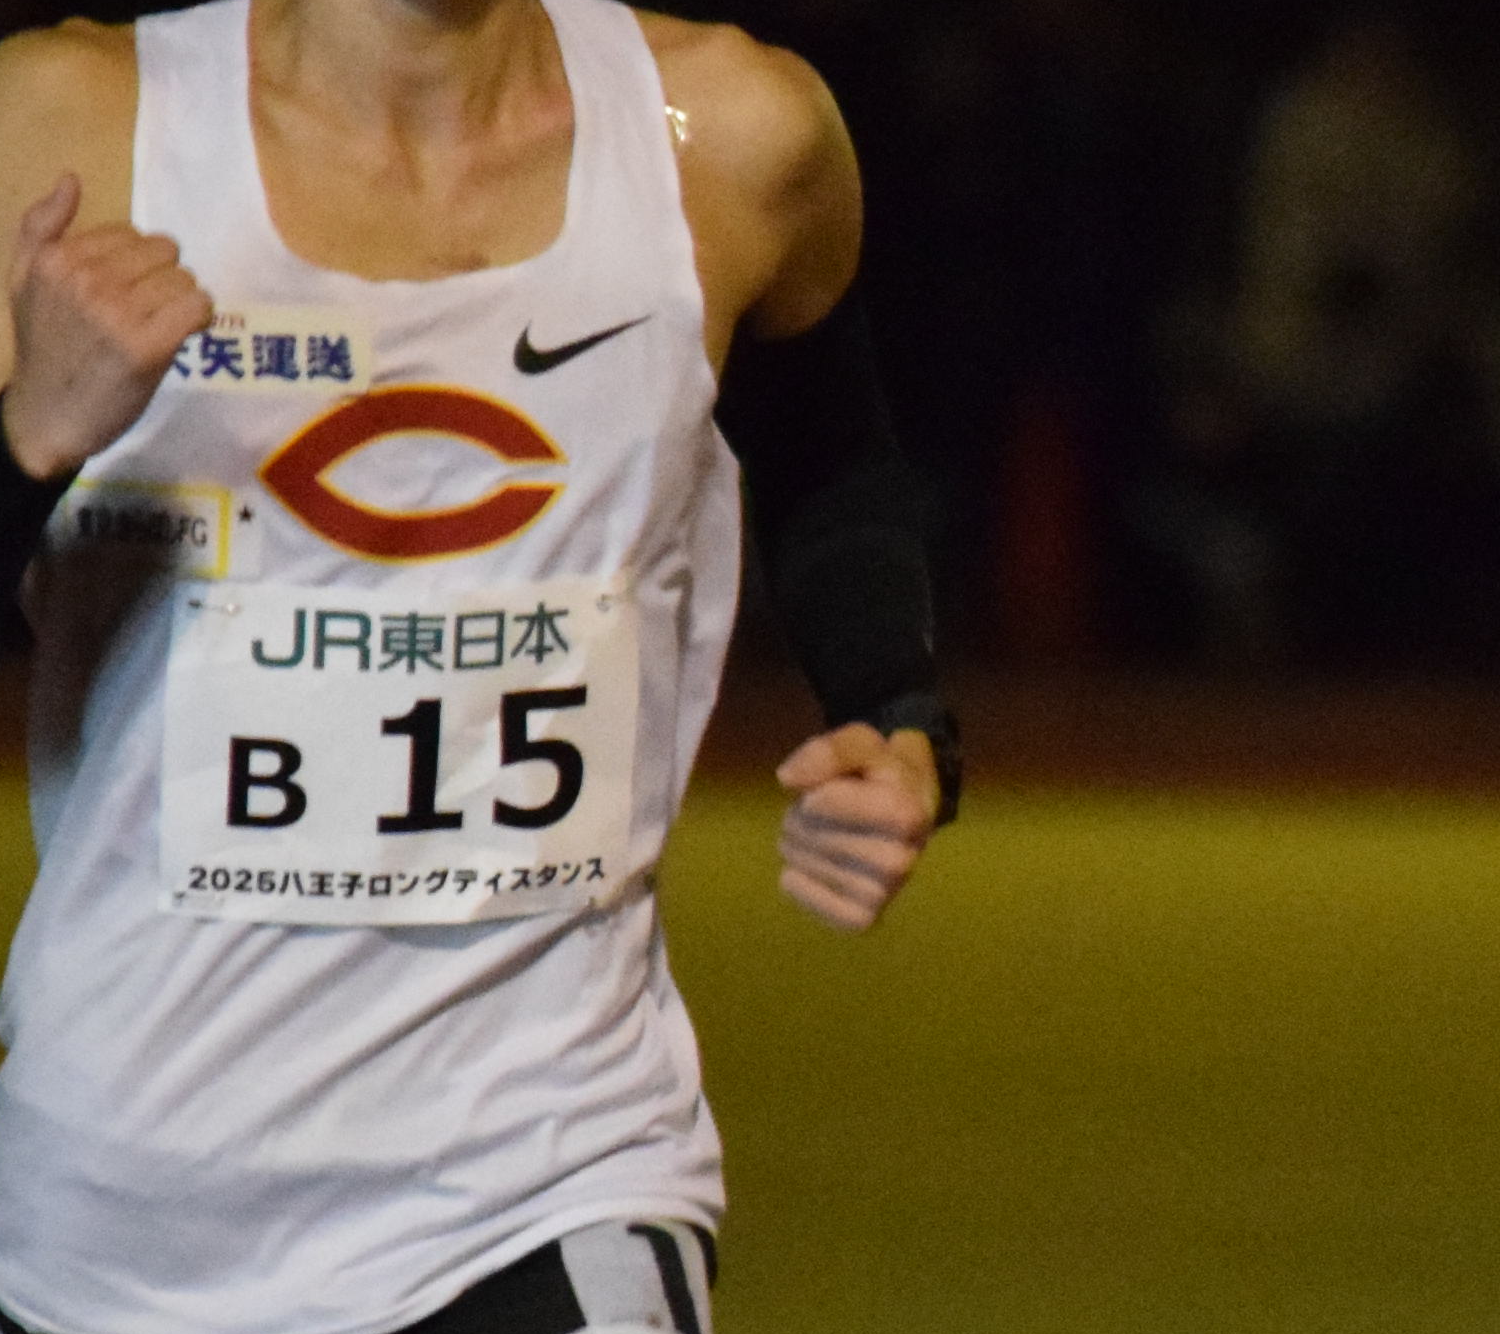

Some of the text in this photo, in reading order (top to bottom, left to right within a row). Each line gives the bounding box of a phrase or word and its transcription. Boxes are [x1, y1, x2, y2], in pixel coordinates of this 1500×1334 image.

[251, 602, 570, 674] JR東日本
[226, 683, 588, 835] B 15
